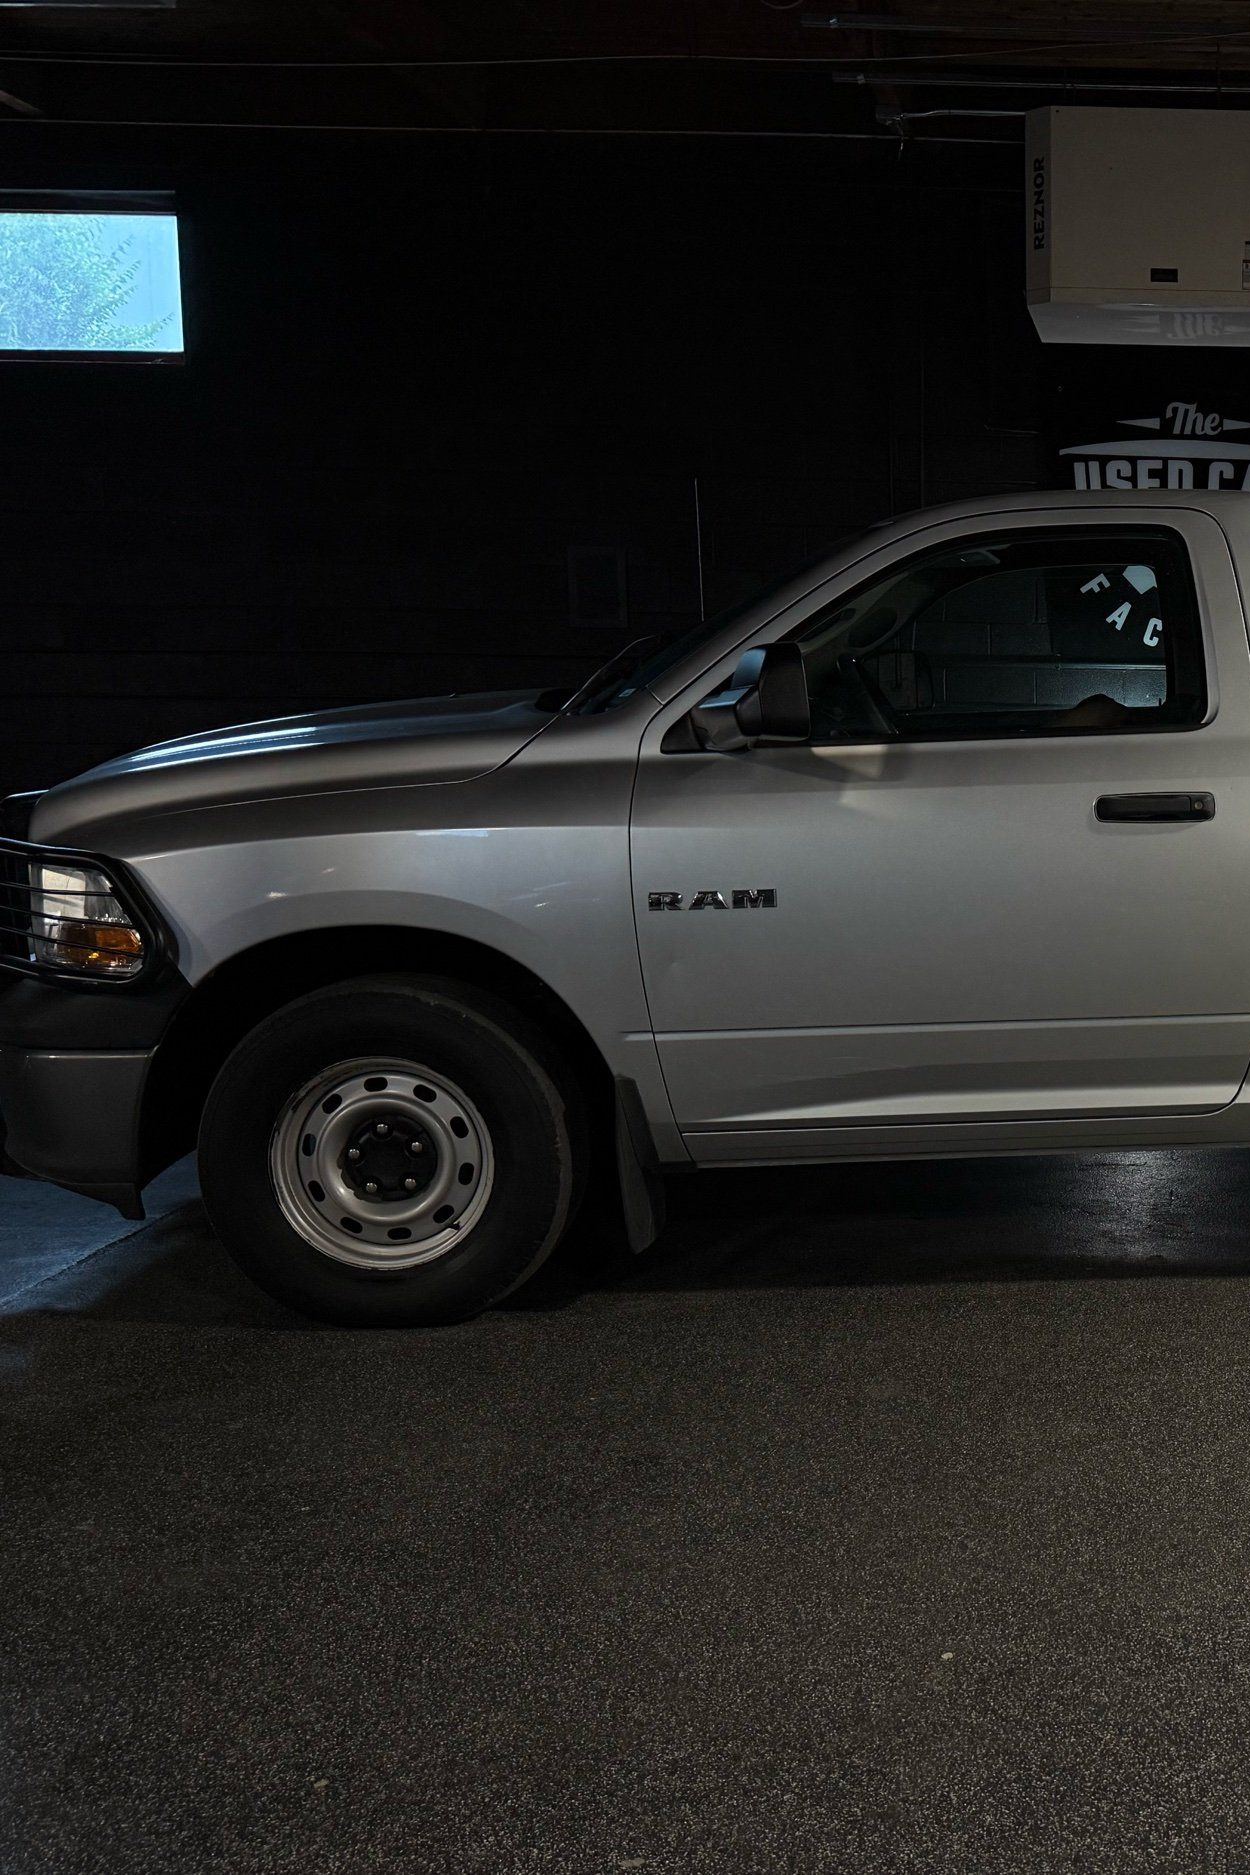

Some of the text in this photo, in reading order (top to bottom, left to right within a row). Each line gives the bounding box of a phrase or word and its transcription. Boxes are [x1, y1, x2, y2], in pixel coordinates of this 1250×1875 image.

[1033, 157, 1045, 250] REZNOR
[1165, 401, 1224, 436] The
[648, 889, 777, 911] RAM
